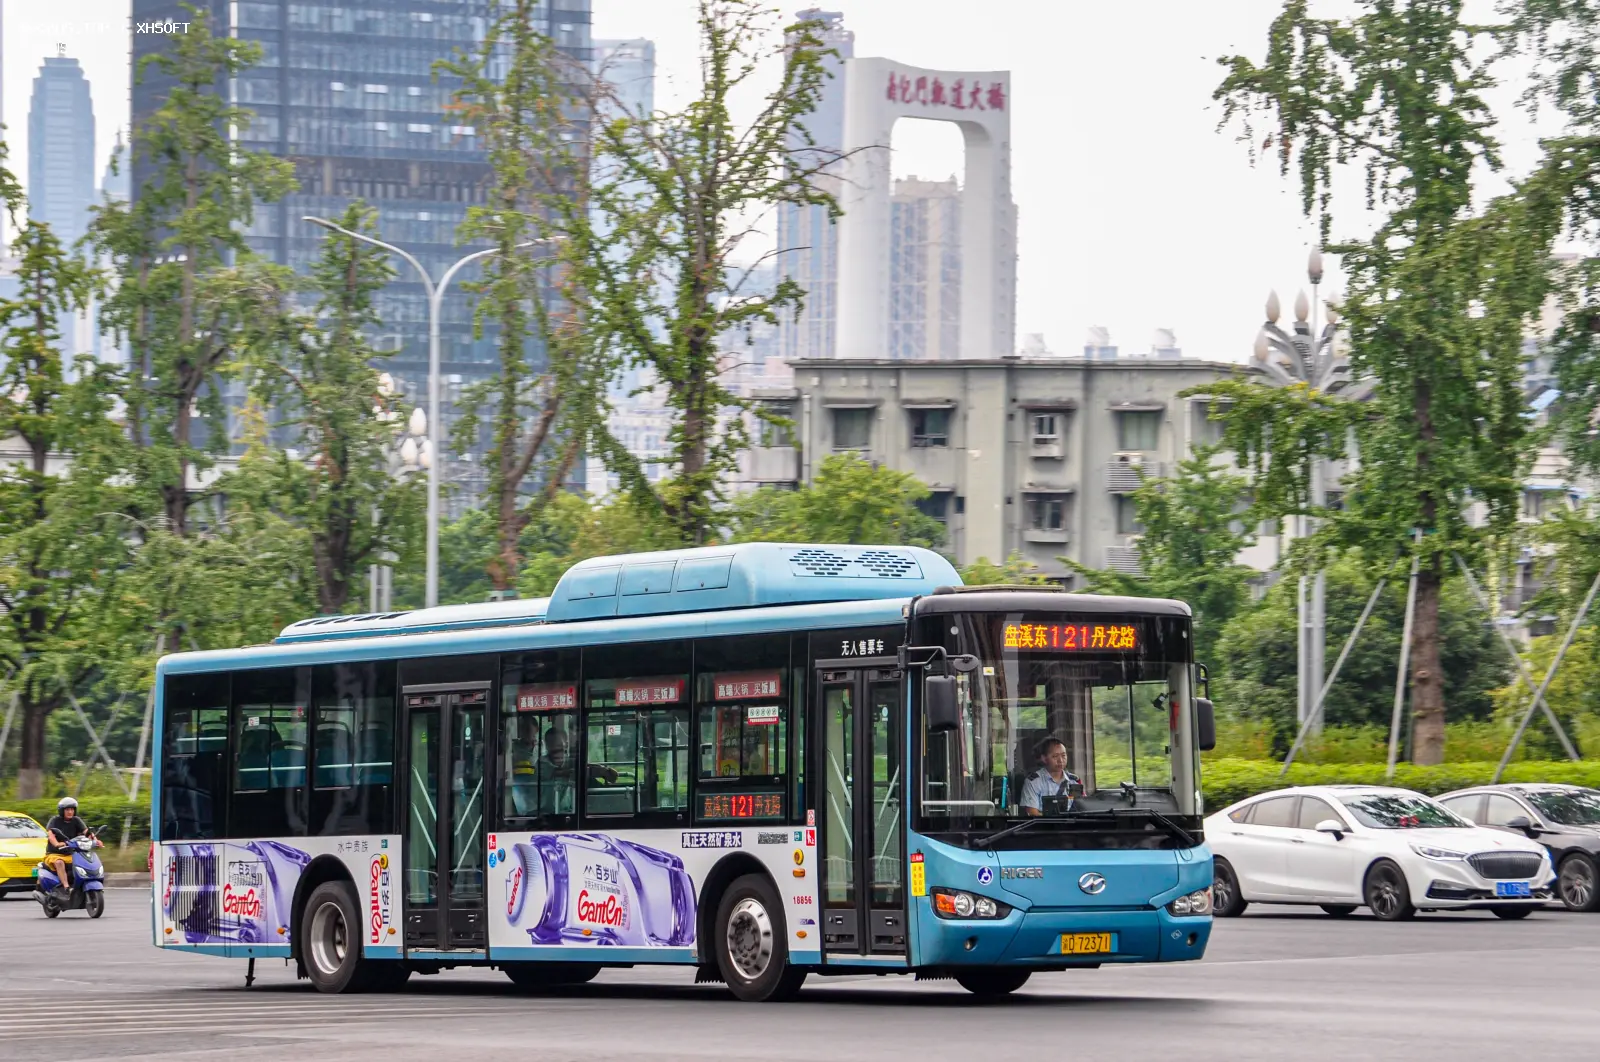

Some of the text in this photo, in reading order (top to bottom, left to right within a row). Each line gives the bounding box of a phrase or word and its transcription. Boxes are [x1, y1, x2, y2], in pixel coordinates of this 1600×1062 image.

[1004, 624, 1136, 648] 盘溪东 121 丹龙路
[841, 638, 884, 656] 无人售票车
[731, 795, 753, 817] 121
[337, 840, 369, 853] 水中贵族
[682, 832, 742, 848] 真正天然矿泉水
[595, 864, 618, 884] 百岁山
[1001, 867, 1044, 879] HIGER
[223, 883, 261, 918] Ganten
[371, 859, 383, 944] Ganten
[578, 889, 622, 926] Ganten
[792, 896, 812, 905] 18856
